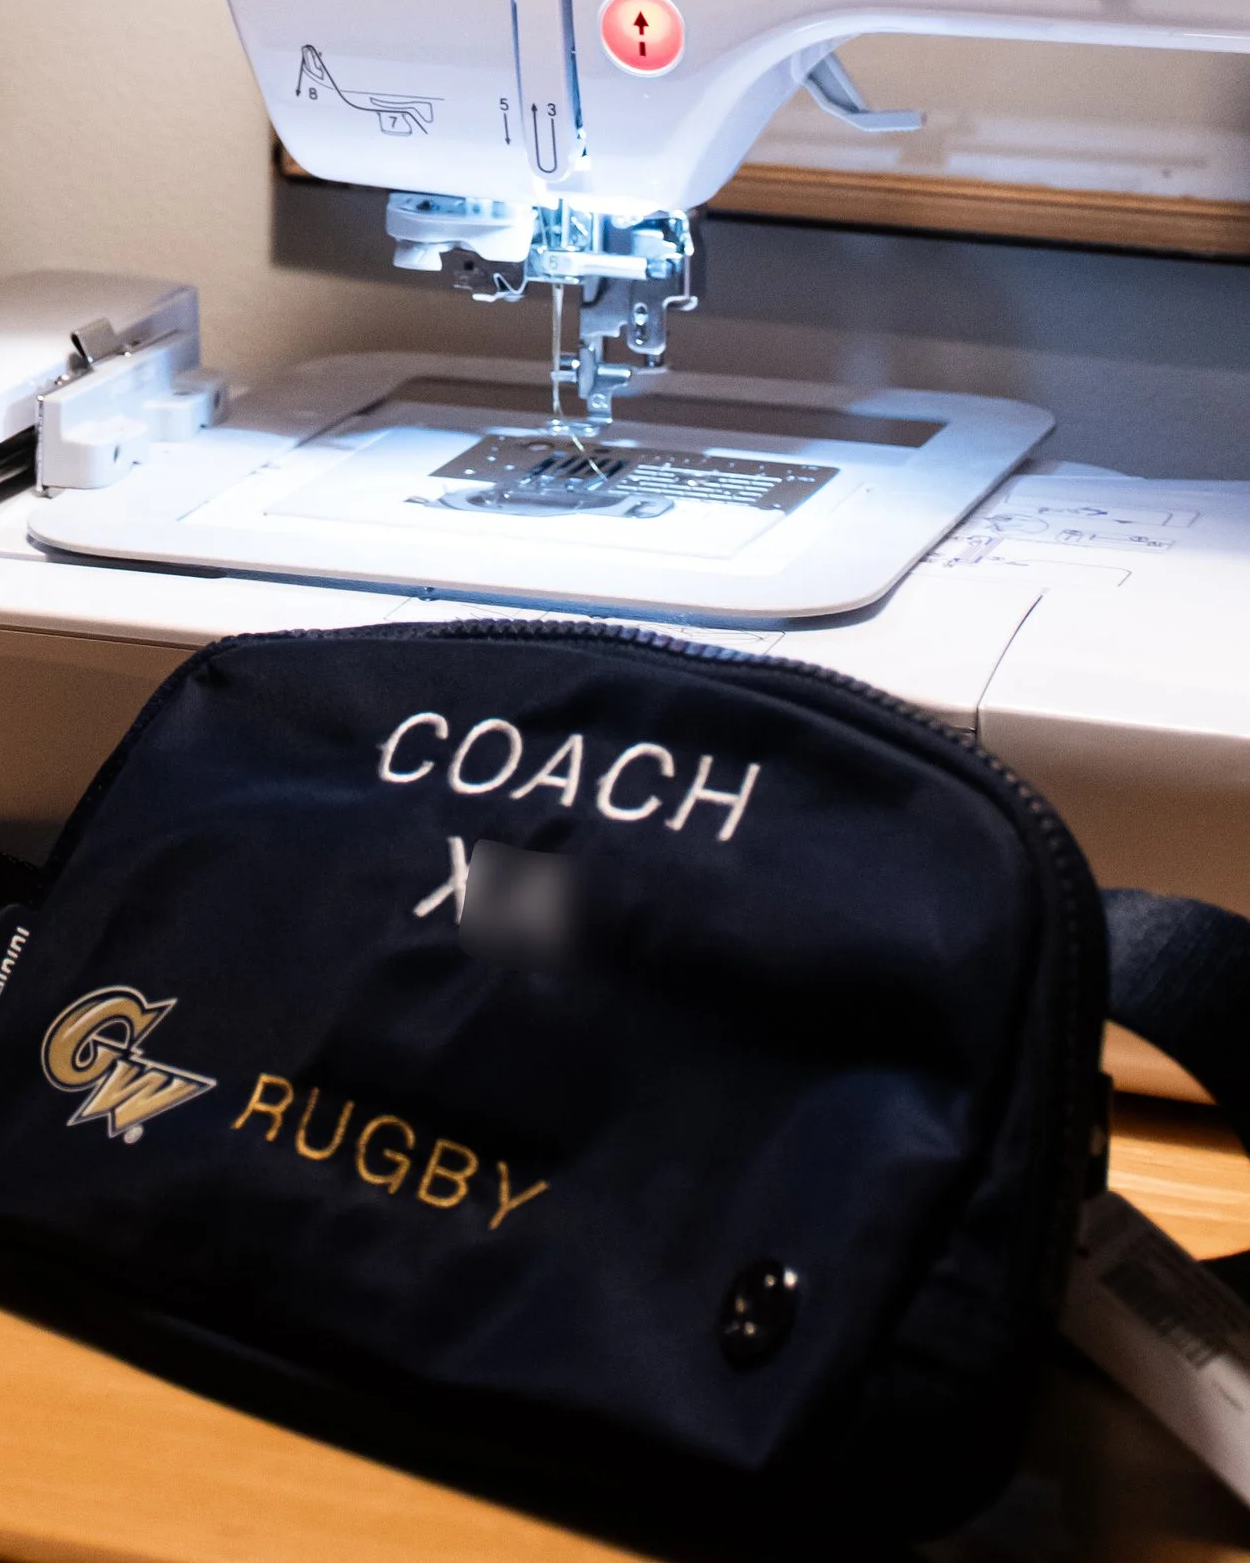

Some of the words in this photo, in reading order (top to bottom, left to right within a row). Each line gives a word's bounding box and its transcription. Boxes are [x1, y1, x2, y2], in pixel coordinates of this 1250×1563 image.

[499, 97, 510, 112] 5
[547, 102, 557, 117] 3
[388, 115, 399, 129] 7
[376, 711, 761, 842] COACH
[229, 1072, 550, 1231] RUGBY
